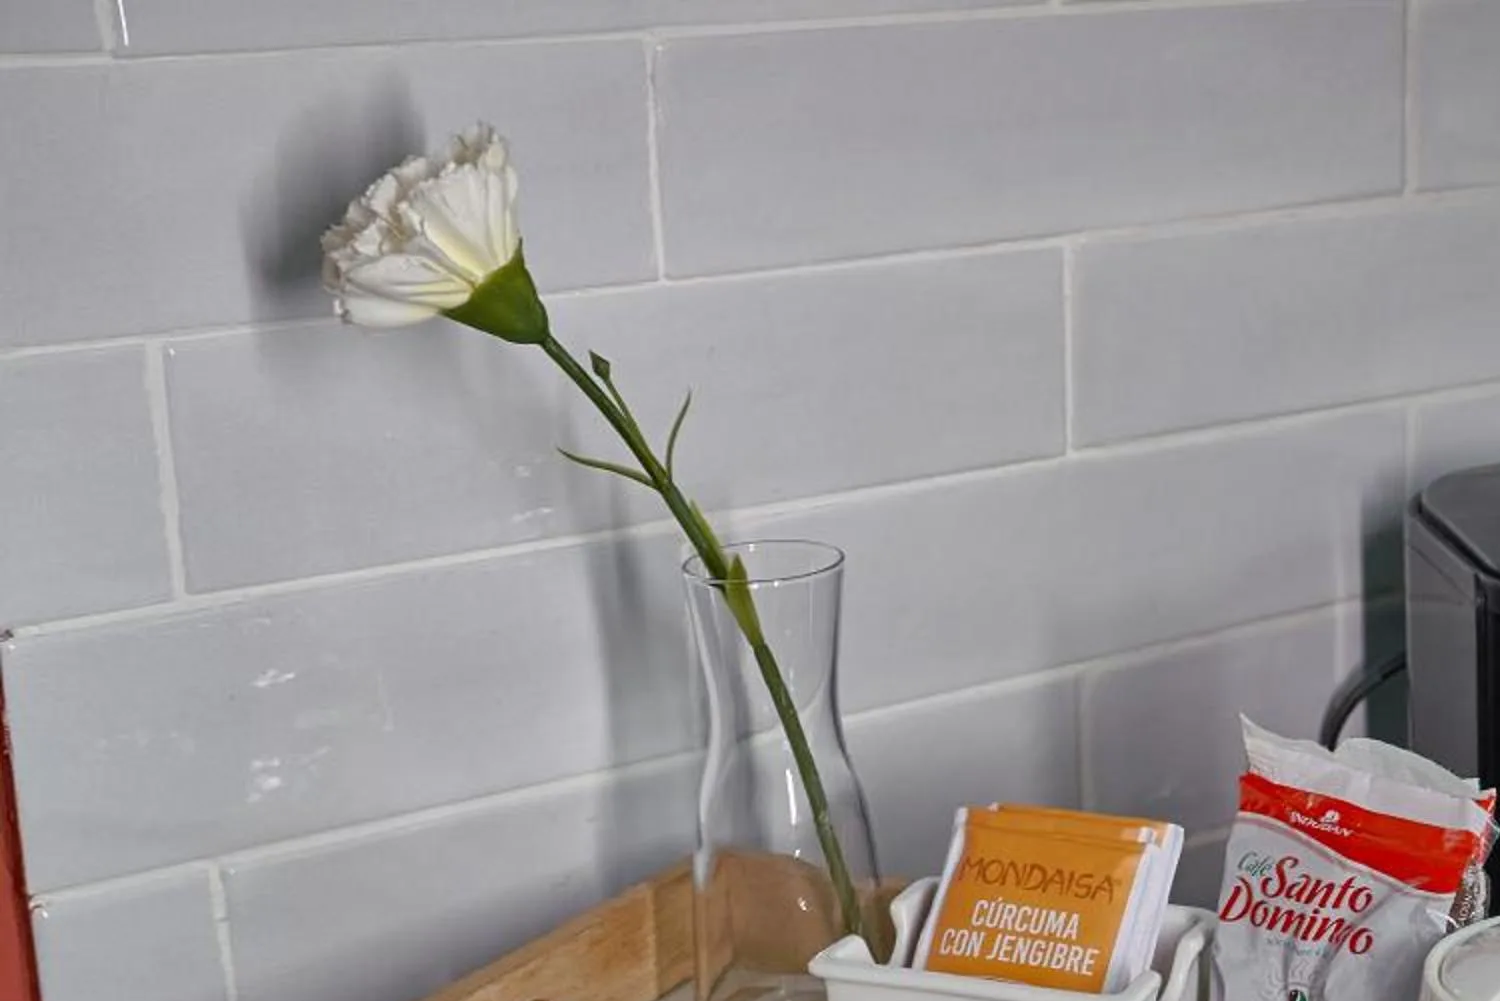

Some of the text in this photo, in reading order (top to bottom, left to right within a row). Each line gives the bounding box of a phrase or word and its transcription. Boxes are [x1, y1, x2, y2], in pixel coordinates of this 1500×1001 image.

[958, 856, 1114, 903] MONDAISA
[1261, 855, 1373, 913] Santo
[971, 897, 1080, 941] CÚRCUMA
[939, 927, 1100, 976] CON JENGIBRE
